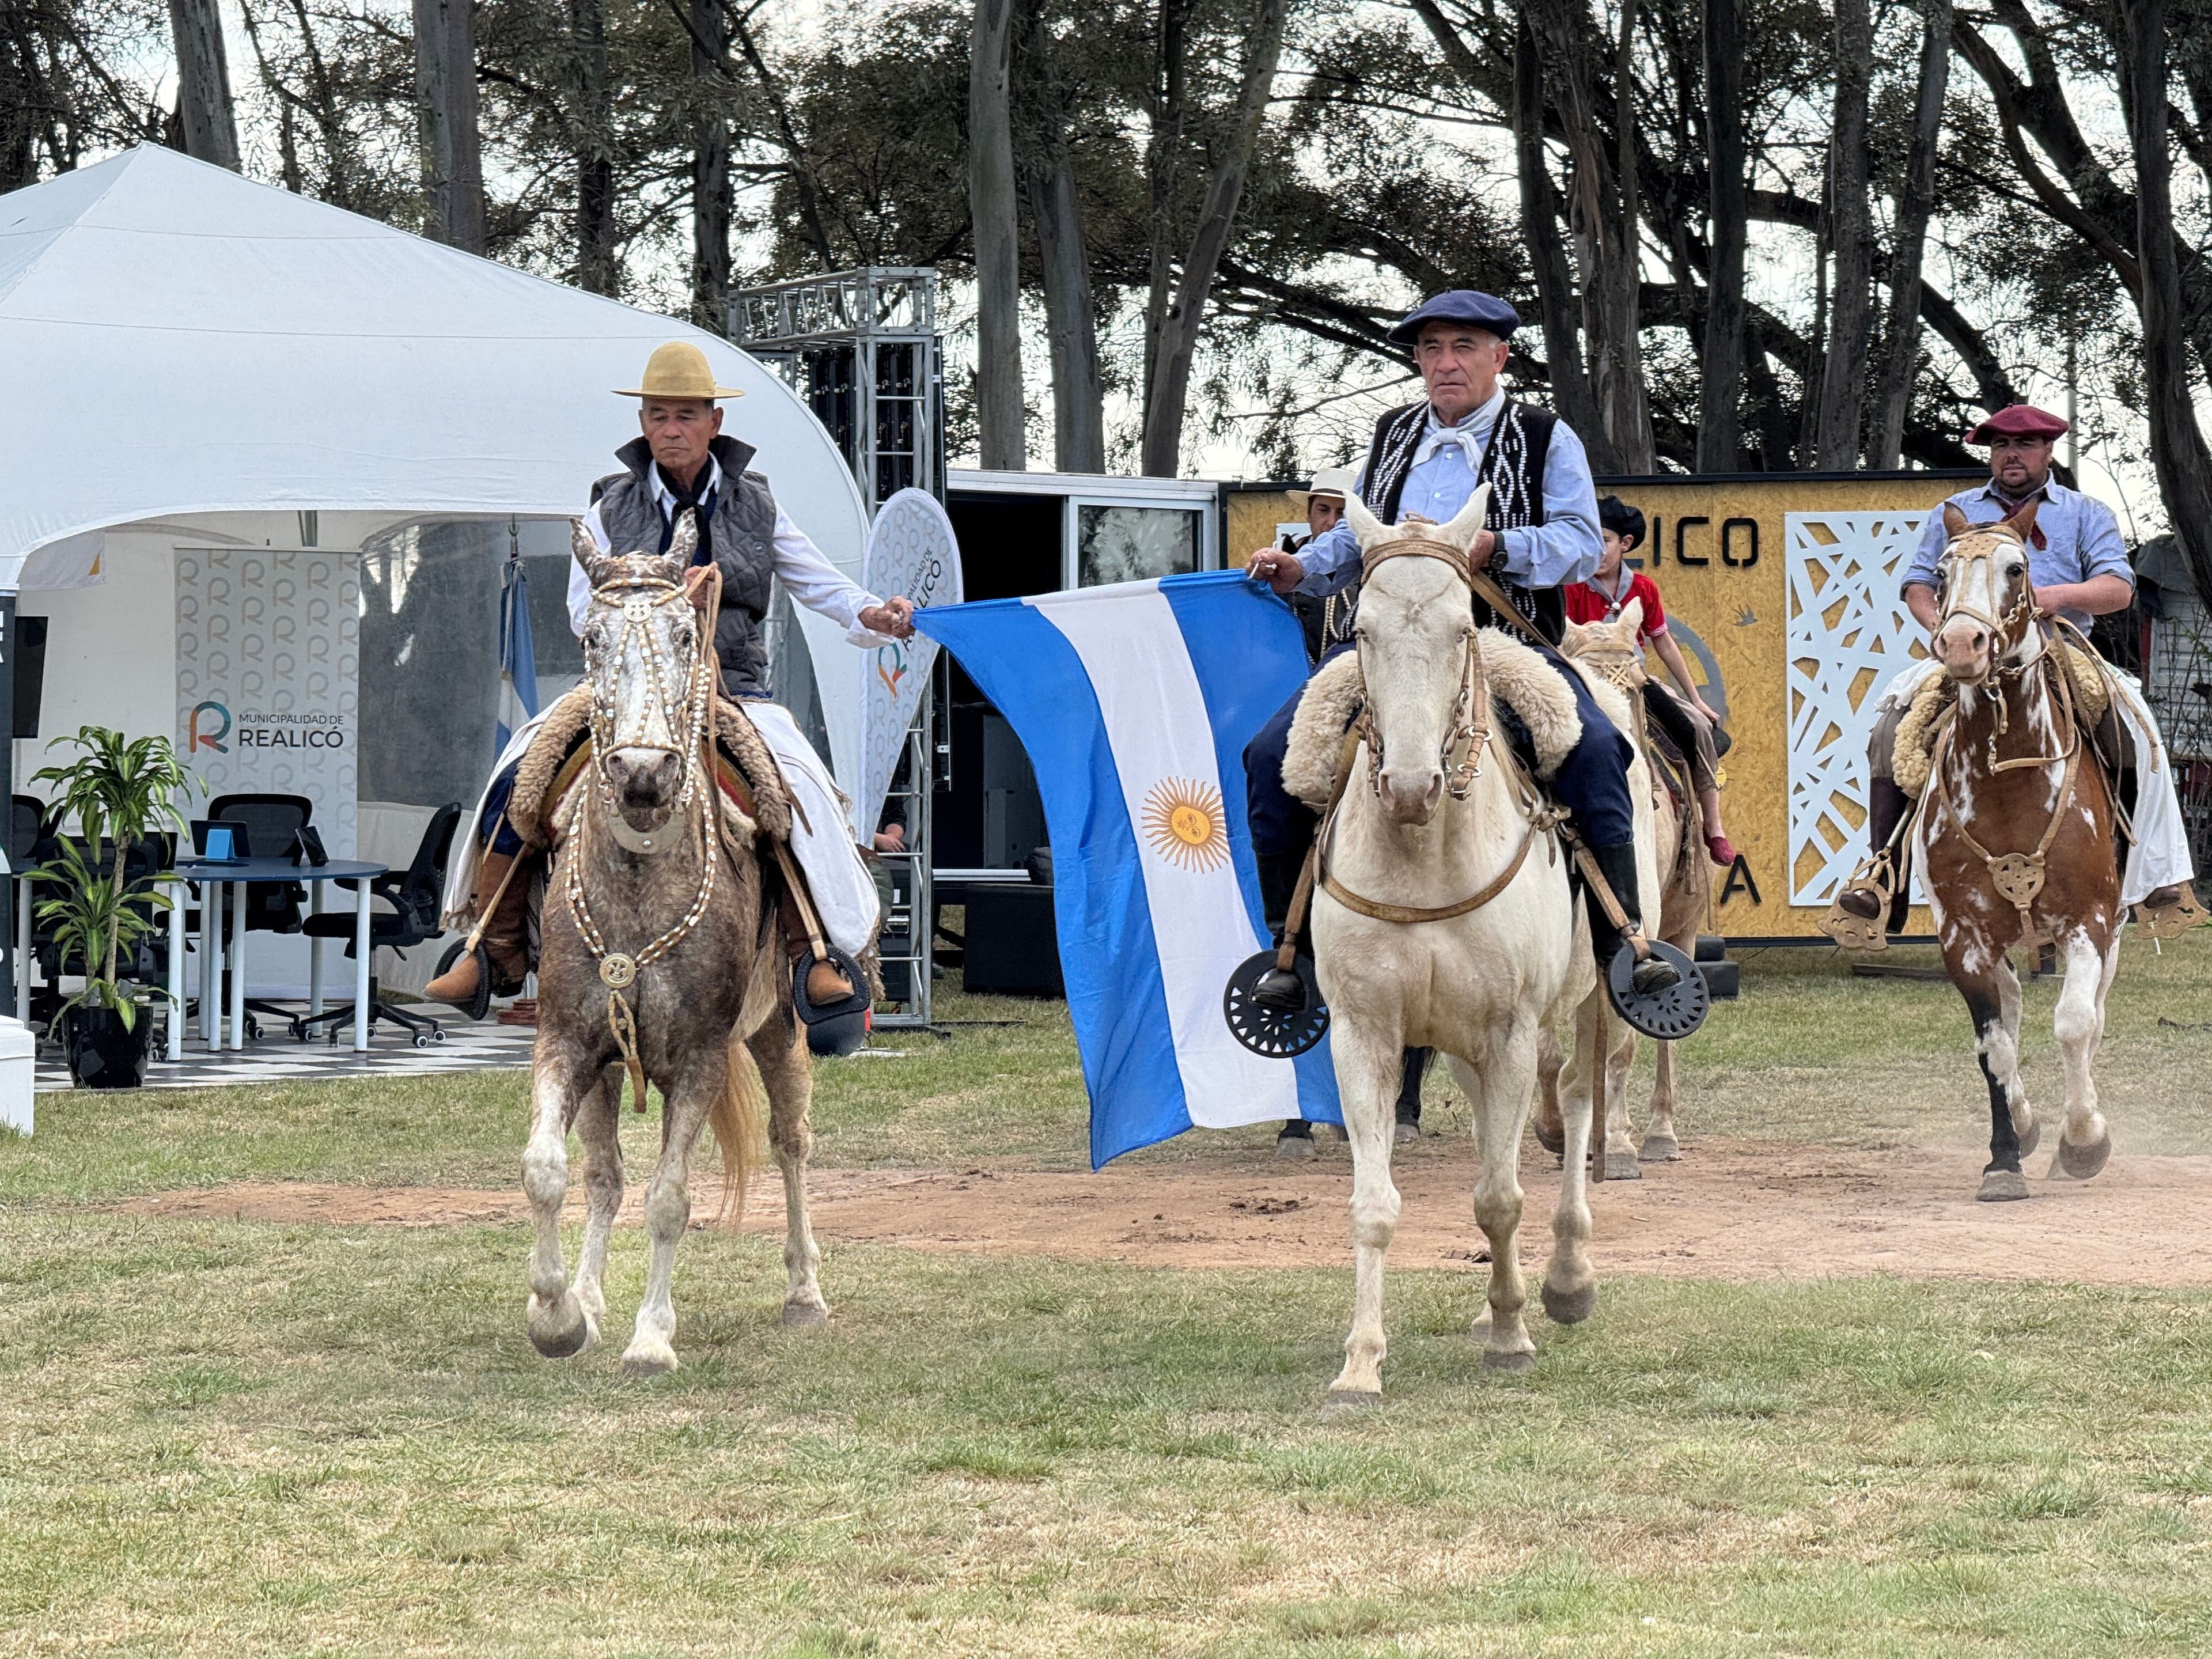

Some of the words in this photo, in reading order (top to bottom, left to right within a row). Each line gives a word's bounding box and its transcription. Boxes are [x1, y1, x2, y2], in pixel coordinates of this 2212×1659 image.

[1623, 516, 1759, 567] ICO
[239, 714, 327, 725] MUNICIPALIDAD
[329, 715, 344, 725] DE
[239, 726, 344, 748] REALICÓ
